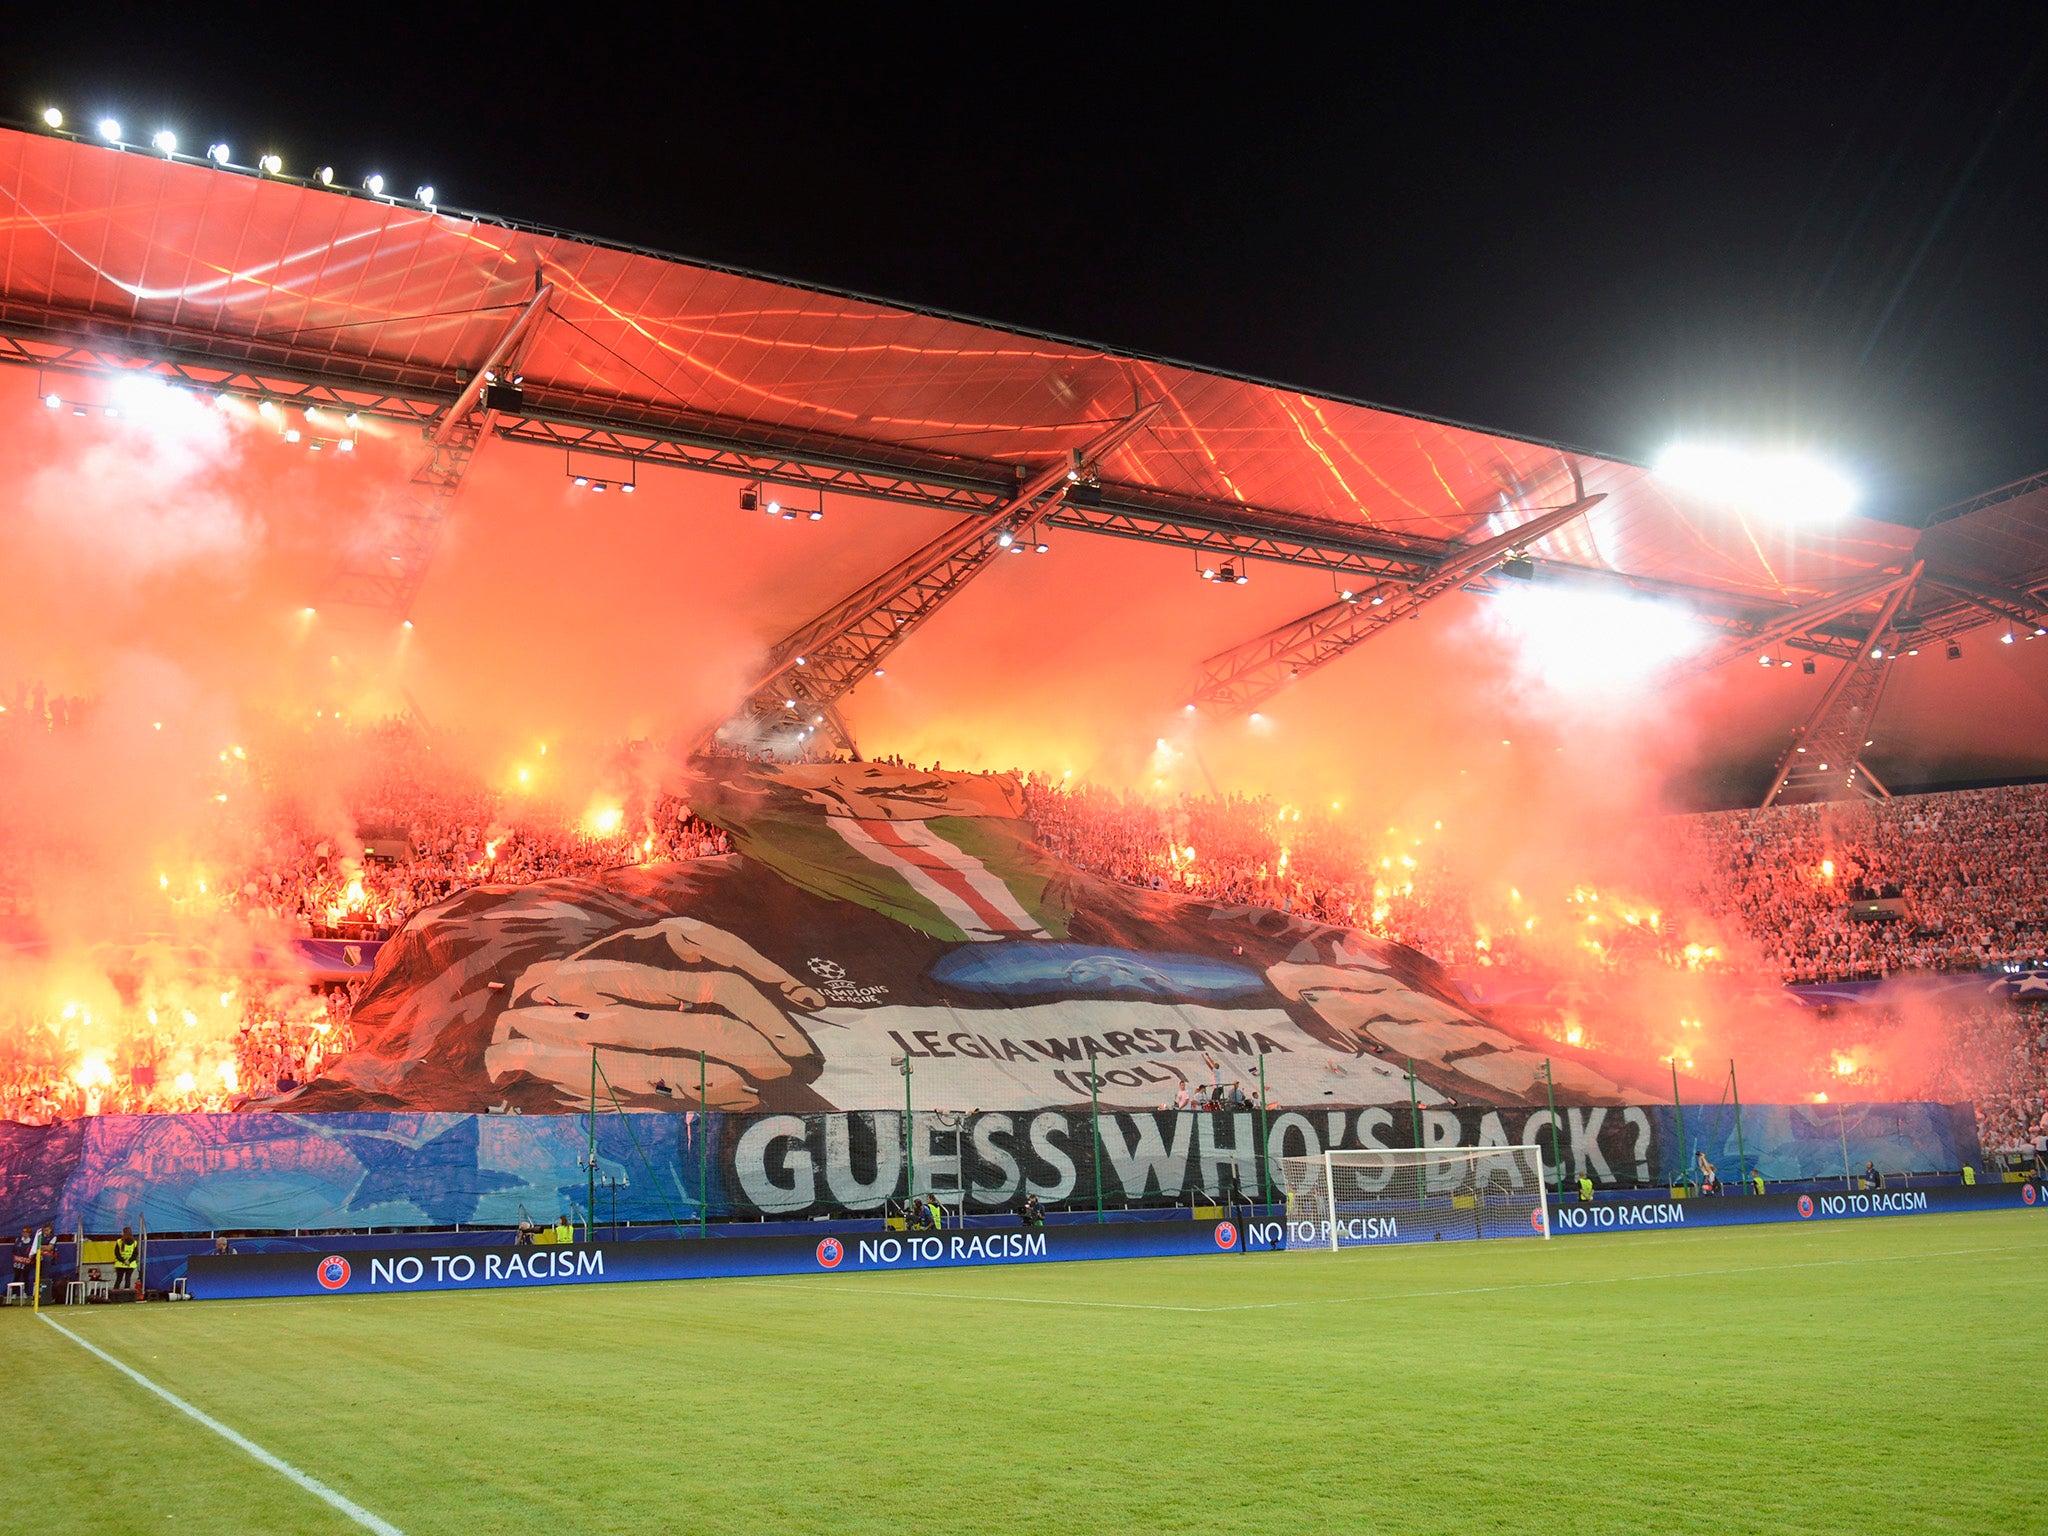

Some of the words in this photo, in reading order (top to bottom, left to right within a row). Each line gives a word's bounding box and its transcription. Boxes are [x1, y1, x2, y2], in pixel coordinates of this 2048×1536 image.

[816, 985, 890, 998] AMPIONS
[830, 995, 878, 1004] LEAGUE
[887, 1030, 1039, 1063] LEGIA
[1027, 1027, 1293, 1063] WARSZAWA
[1054, 1060, 1190, 1097] (POL)
[734, 1111, 1076, 1214] GUESS
[1097, 1107, 1394, 1200] WHO'S
[1424, 1105, 1652, 1195] BACK?
[1558, 1207, 1588, 1228] NO
[1590, 1206, 1614, 1226] TO
[1618, 1203, 1684, 1225] RACISM
[1820, 1195, 1847, 1214] NO
[1848, 1194, 1870, 1213] TO
[1872, 1192, 1927, 1211] RACISM
[1249, 1223, 1282, 1244] NO
[1286, 1221, 1316, 1242] TO
[859, 1238, 901, 1263] NO
[907, 1237, 943, 1261] TO
[951, 1233, 1047, 1259] RACISM
[324, 1258, 345, 1266] UEFA
[371, 1256, 424, 1284] NO
[431, 1255, 475, 1282] TO
[485, 1250, 604, 1280] RACISM
